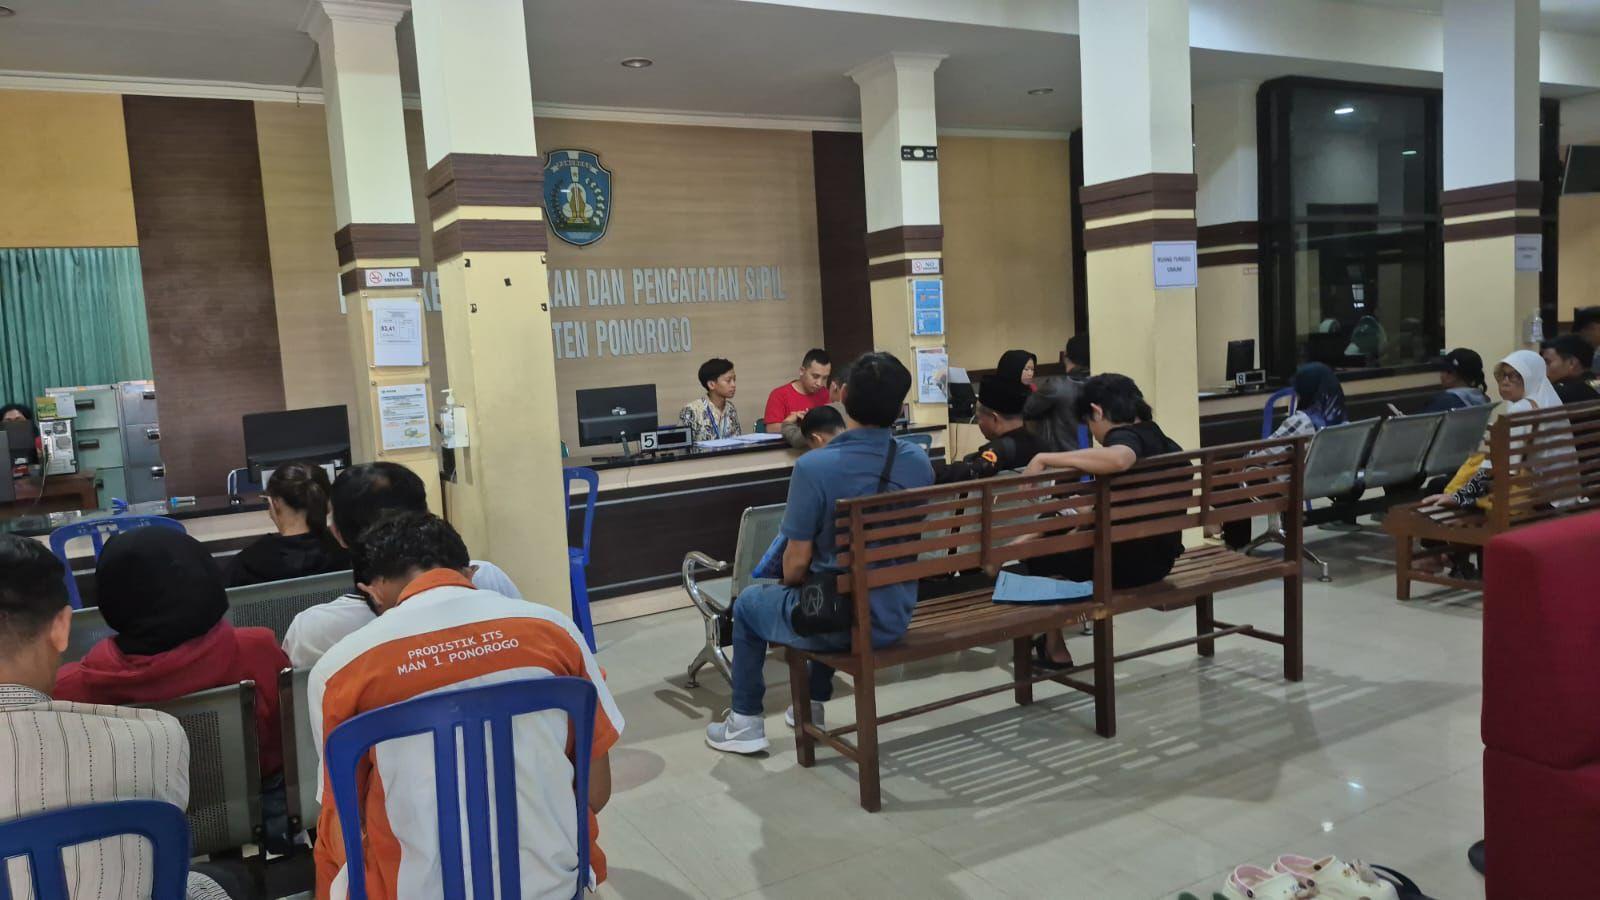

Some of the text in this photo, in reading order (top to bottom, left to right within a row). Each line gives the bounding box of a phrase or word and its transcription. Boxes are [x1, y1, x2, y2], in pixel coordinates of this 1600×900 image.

[586, 268, 625, 306] DAN
[633, 266, 740, 305] PENCATATAN
[745, 265, 787, 300] SIPIL
[596, 316, 692, 357] PONOROGO
[644, 434, 654, 448] 5
[397, 638, 519, 676] MAN 1 PONOROGO
[407, 630, 504, 659] PRODISTIK ITS
